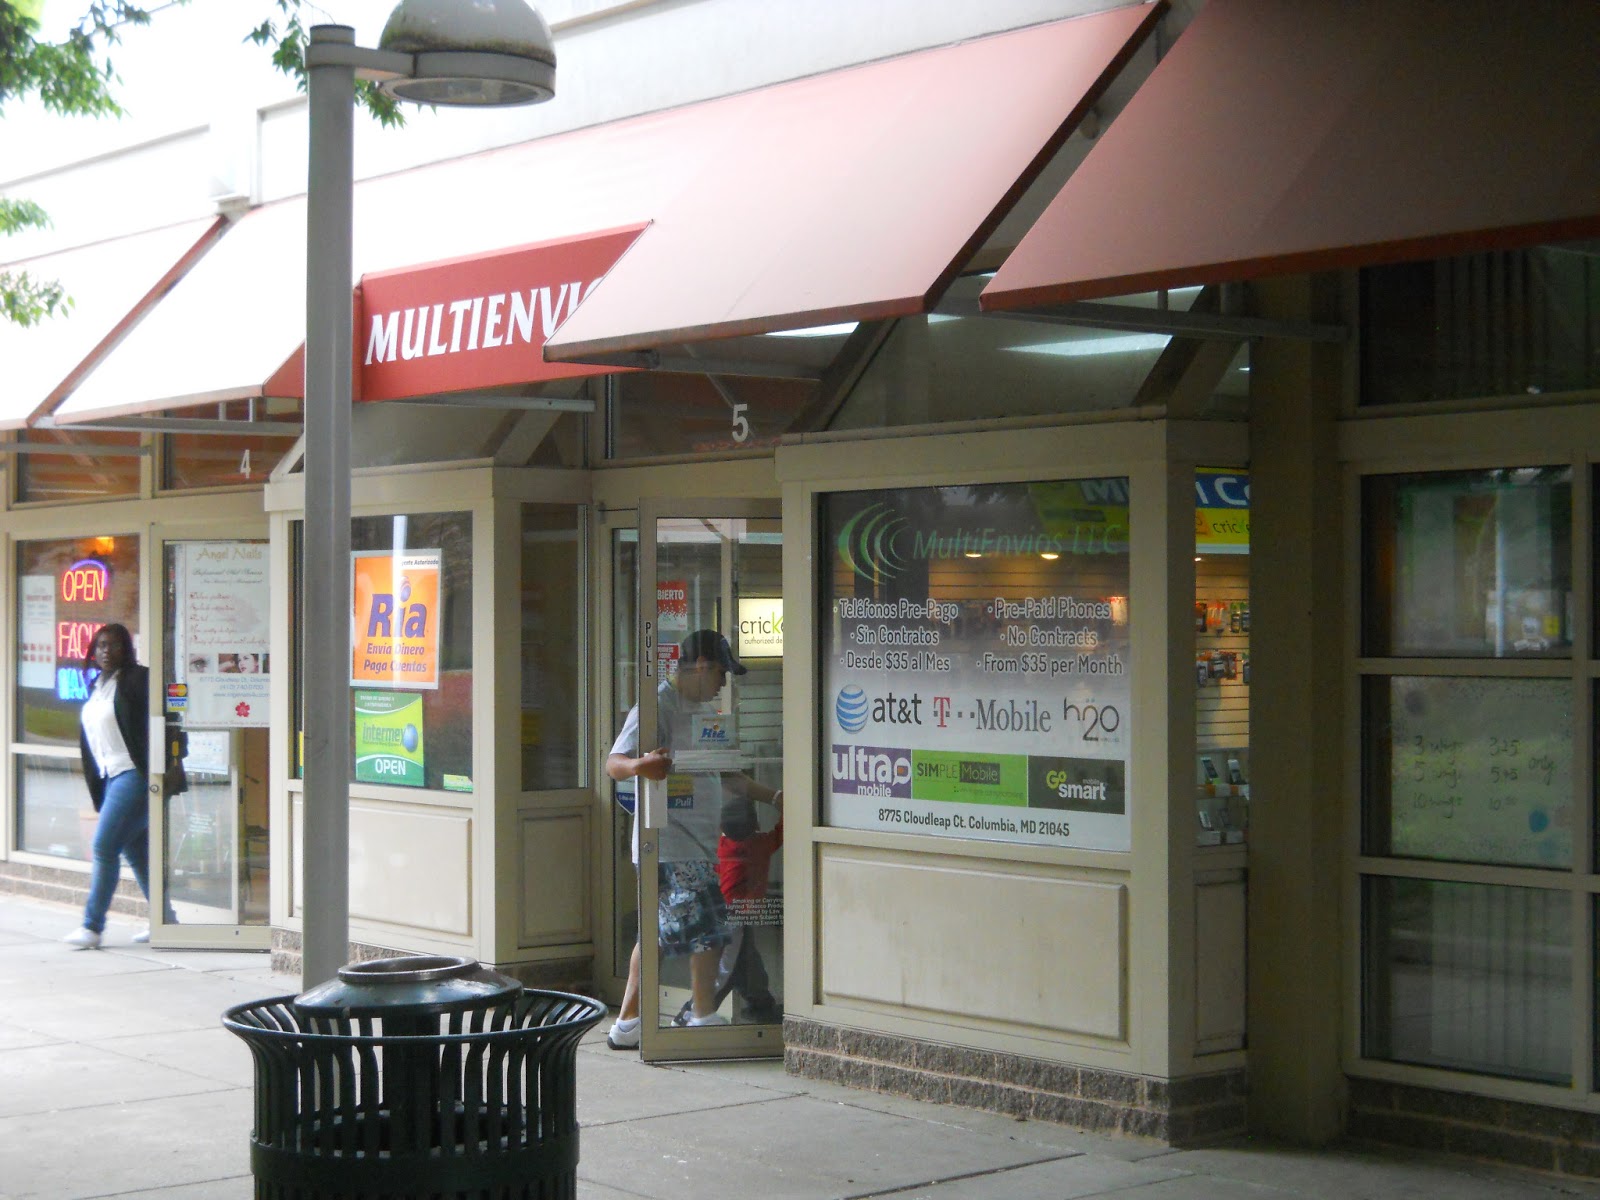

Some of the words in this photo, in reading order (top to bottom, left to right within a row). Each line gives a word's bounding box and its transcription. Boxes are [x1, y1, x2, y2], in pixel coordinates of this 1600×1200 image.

[364, 276, 604, 366] MULTIENVI
[731, 403, 749, 443] 5
[240, 449, 251, 479] 4
[63, 570, 105, 602] OPEN
[899, 598, 959, 624] Pre-Pago
[995, 597, 1057, 618] Pre-Paid
[1058, 597, 1112, 619] Phones
[740, 611, 784, 634] crick
[744, 635, 775, 645] authorized
[856, 624, 877, 645] Sin
[879, 624, 940, 645] Contratos
[1007, 625, 1026, 646] No
[1028, 625, 1098, 648] Contracts
[364, 659, 388, 675] Paga
[847, 650, 882, 669] Desde
[885, 651, 909, 671] $35
[911, 652, 922, 671] al
[925, 653, 951, 671] Mes
[983, 653, 1017, 672] From
[1021, 653, 1047, 674] $35
[1050, 659, 1074, 678] per
[1078, 654, 1123, 675] Month
[872, 692, 922, 725] at&t
[375, 758, 406, 775] OPEN
[917, 762, 958, 779] SIMPLE
[961, 764, 999, 782] Mobile
[857, 784, 892, 798] mobile
[1058, 782, 1107, 801] smart
[878, 808, 902, 823] 8775
[903, 809, 951, 830] Cloudleap
[953, 814, 967, 828] Ct.
[968, 815, 1018, 834] Columbia,
[1020, 819, 1037, 834] MD
[1038, 821, 1070, 837] 21045
